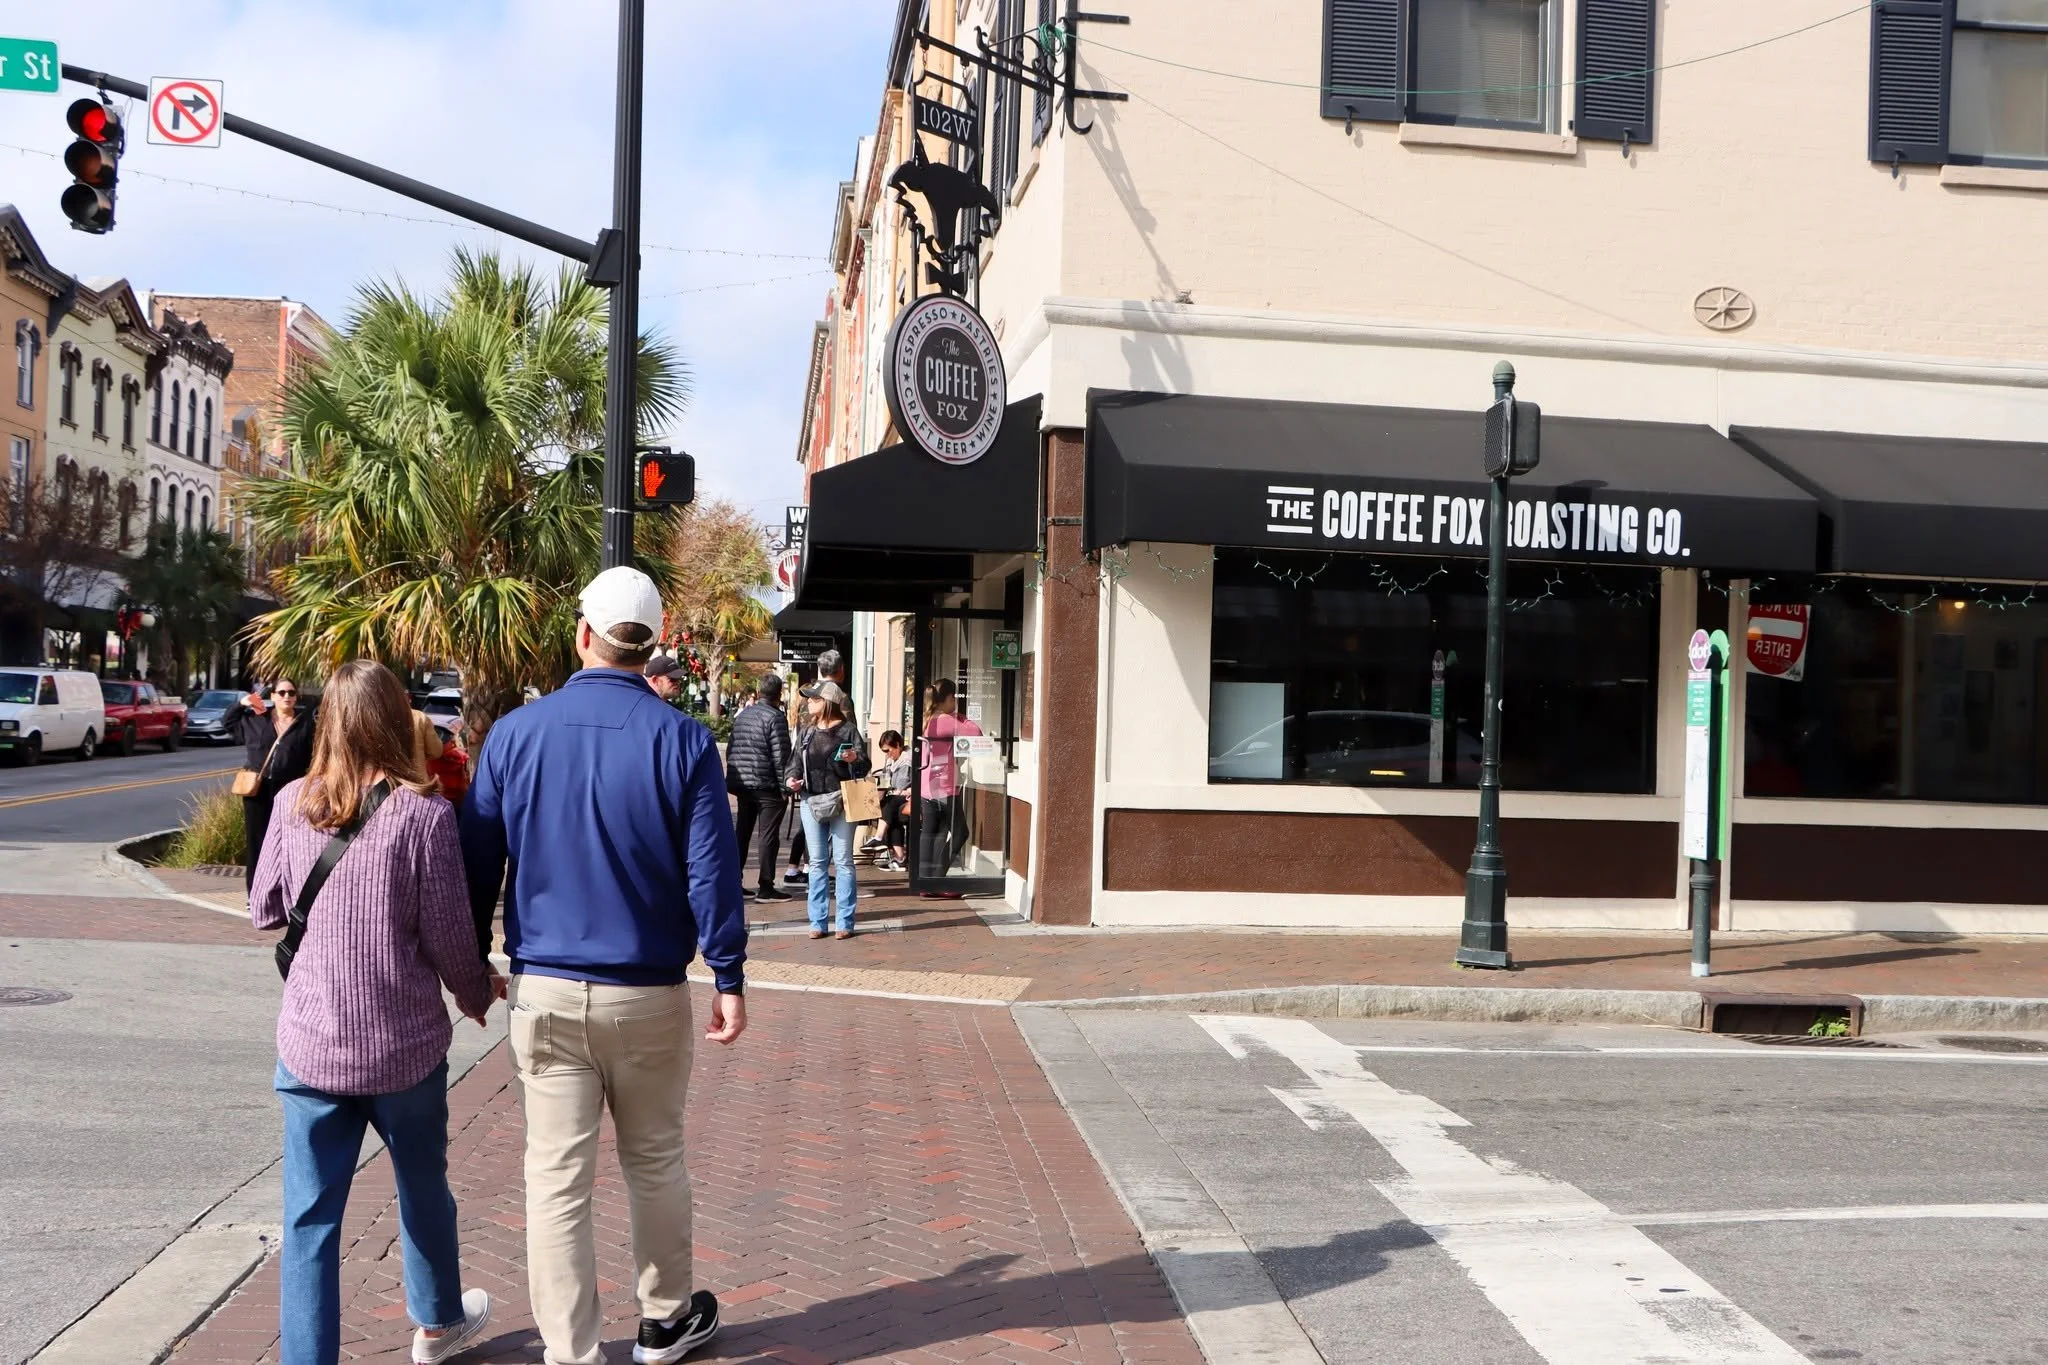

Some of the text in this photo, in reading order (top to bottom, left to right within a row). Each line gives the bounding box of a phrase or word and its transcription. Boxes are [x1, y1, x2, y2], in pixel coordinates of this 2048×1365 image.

[24, 52, 51, 80] St
[920, 102, 973, 140] 102W
[903, 307, 998, 385] ESPRESSO PASTRIES
[941, 337, 961, 356] The
[925, 356, 979, 402] COFFEE
[903, 387, 967, 455] CRAFT BEER
[937, 401, 968, 421] FOX
[976, 404, 997, 442] WINE
[1266, 490, 1691, 557] THE COFFEE FOX OASTING CO.
[1691, 643, 1710, 659] dot
